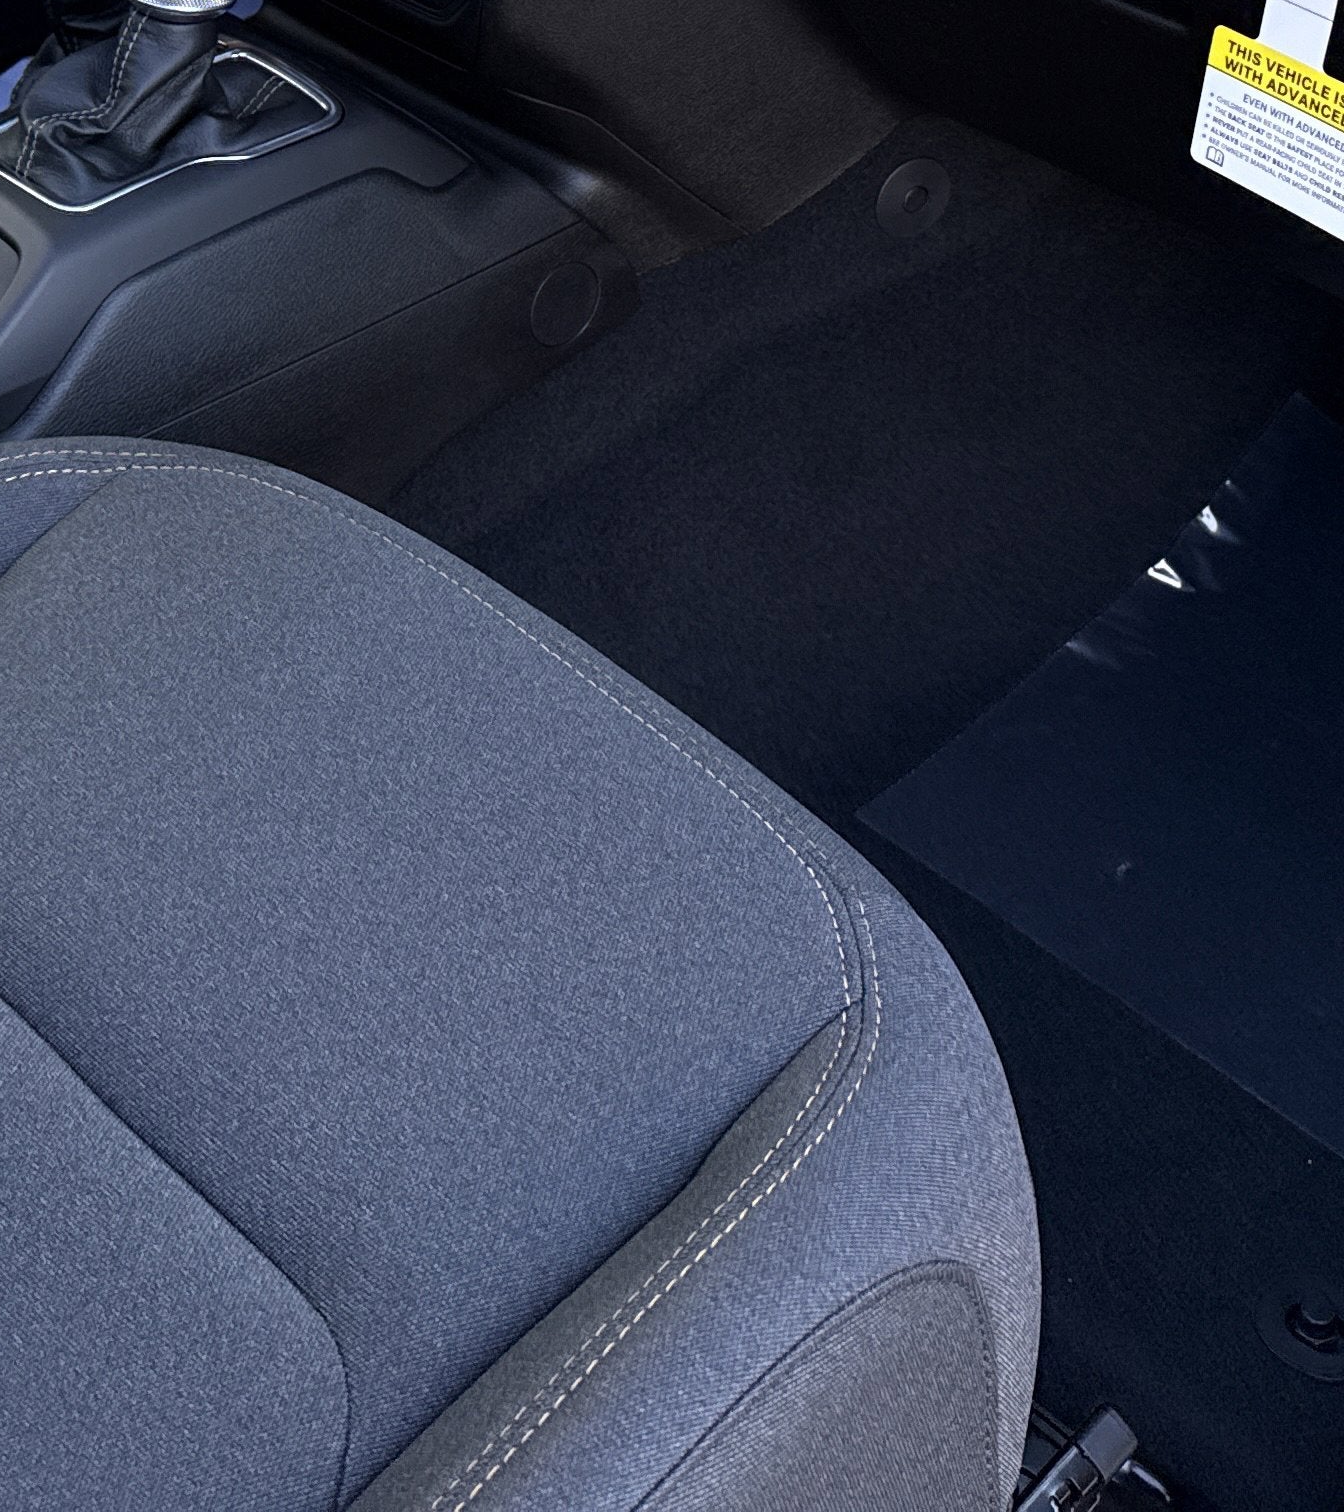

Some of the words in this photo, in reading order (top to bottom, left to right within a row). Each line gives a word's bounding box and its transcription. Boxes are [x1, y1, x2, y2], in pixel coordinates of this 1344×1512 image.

[1224, 55, 1263, 85] WITH
[1227, 38, 1262, 66] THIS
[1264, 57, 1331, 100] VEHICLE
[1216, 95, 1248, 115] CHILDREN
[1248, 111, 1263, 123] CAN
[1243, 93, 1267, 112] EVEN
[1269, 106, 1294, 126] WITH
[1211, 125, 1239, 145] ALWAYS
[1240, 140, 1252, 152] USE
[1253, 148, 1271, 162] SEAT
[1294, 169, 1308, 181] AND
[1309, 177, 1331, 194] CHILD
[1212, 115, 1235, 131] NEVER
[1236, 127, 1249, 138] PUT
[1297, 159, 1317, 174] CHILD
[1227, 111, 1247, 126] BACK
[1248, 122, 1265, 136] SEAT
[1286, 142, 1312, 160] SAFEST
[1314, 156, 1335, 172] PLACE
[1250, 158, 1277, 177] MANUAL
[1278, 172, 1291, 184] FOR
[1292, 180, 1310, 194] MORE
